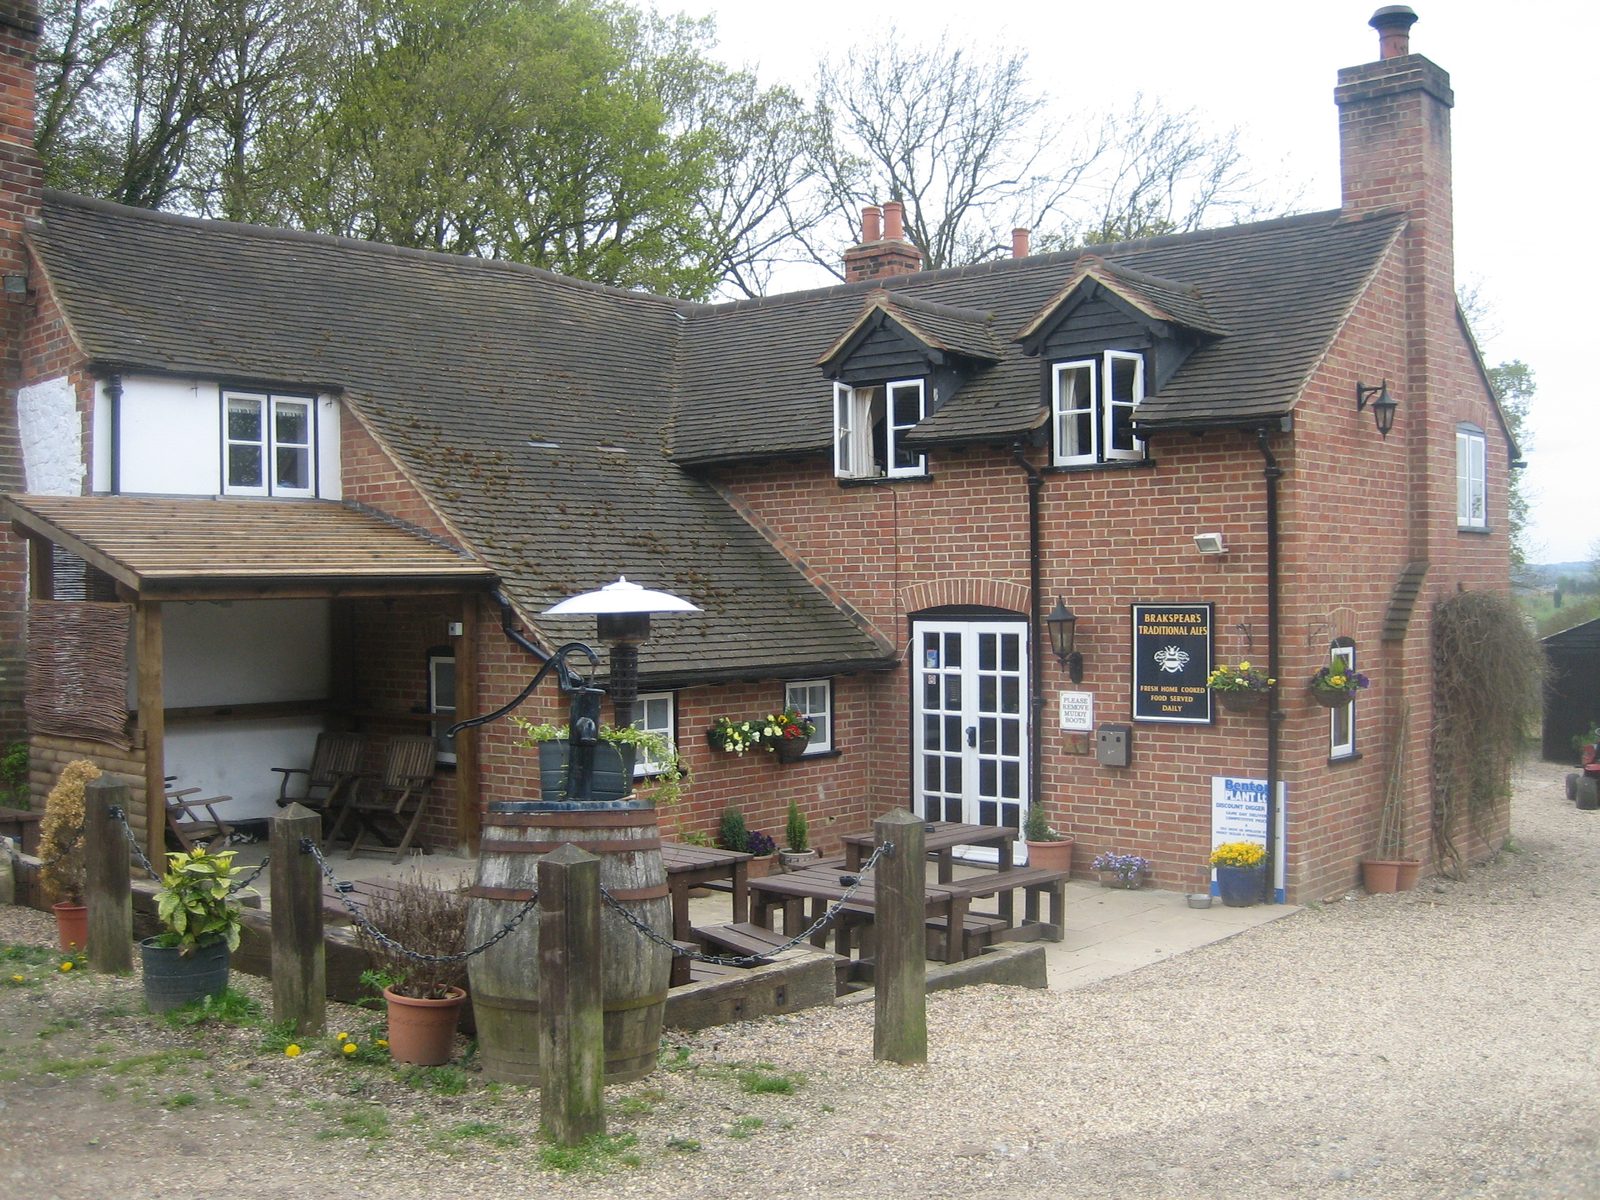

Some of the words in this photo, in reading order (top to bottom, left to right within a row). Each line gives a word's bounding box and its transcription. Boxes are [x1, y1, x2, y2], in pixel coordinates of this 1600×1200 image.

[1138, 626, 1188, 635] TRADITIONAL
[1190, 626, 1207, 635] ALES
[1225, 790, 1256, 802] PLANT
